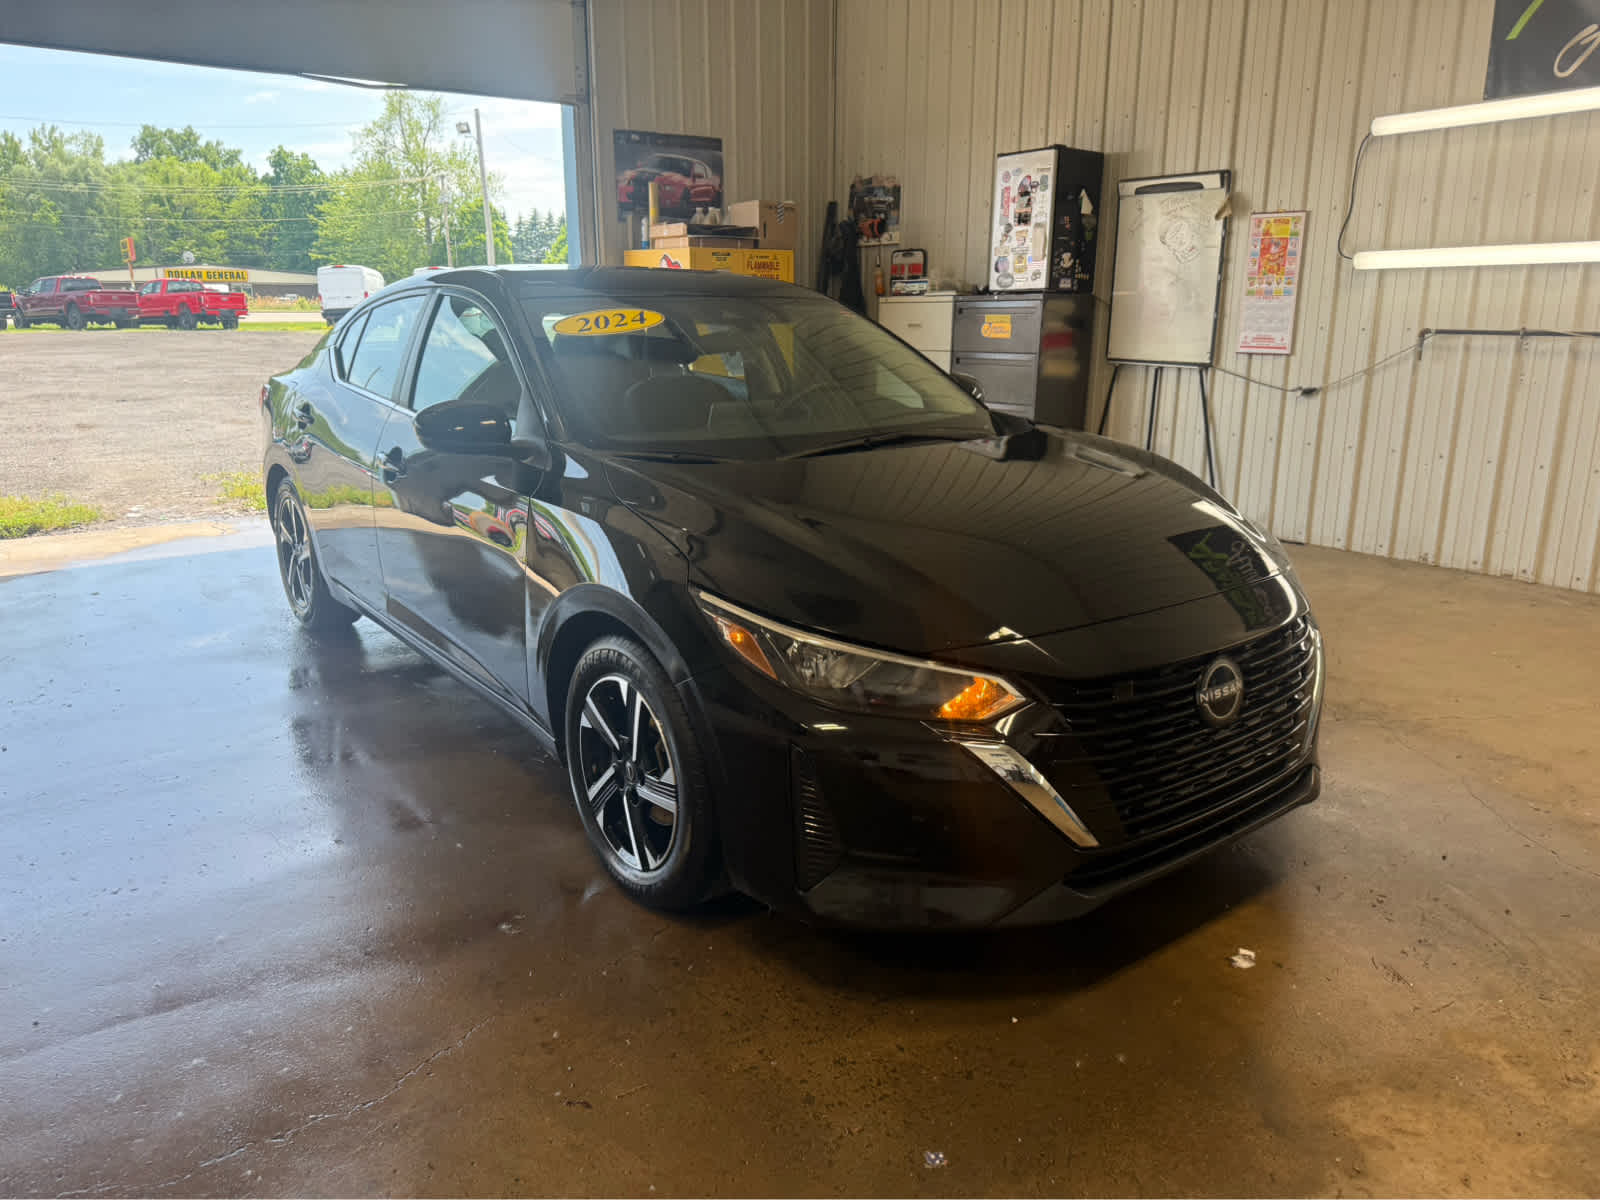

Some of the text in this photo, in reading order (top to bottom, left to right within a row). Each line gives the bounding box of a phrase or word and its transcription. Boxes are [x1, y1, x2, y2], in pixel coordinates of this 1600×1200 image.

[167, 270, 246, 280] DOLLAR GENERAL
[576, 311, 647, 333] 2024
[1200, 680, 1242, 704] NISSAN
